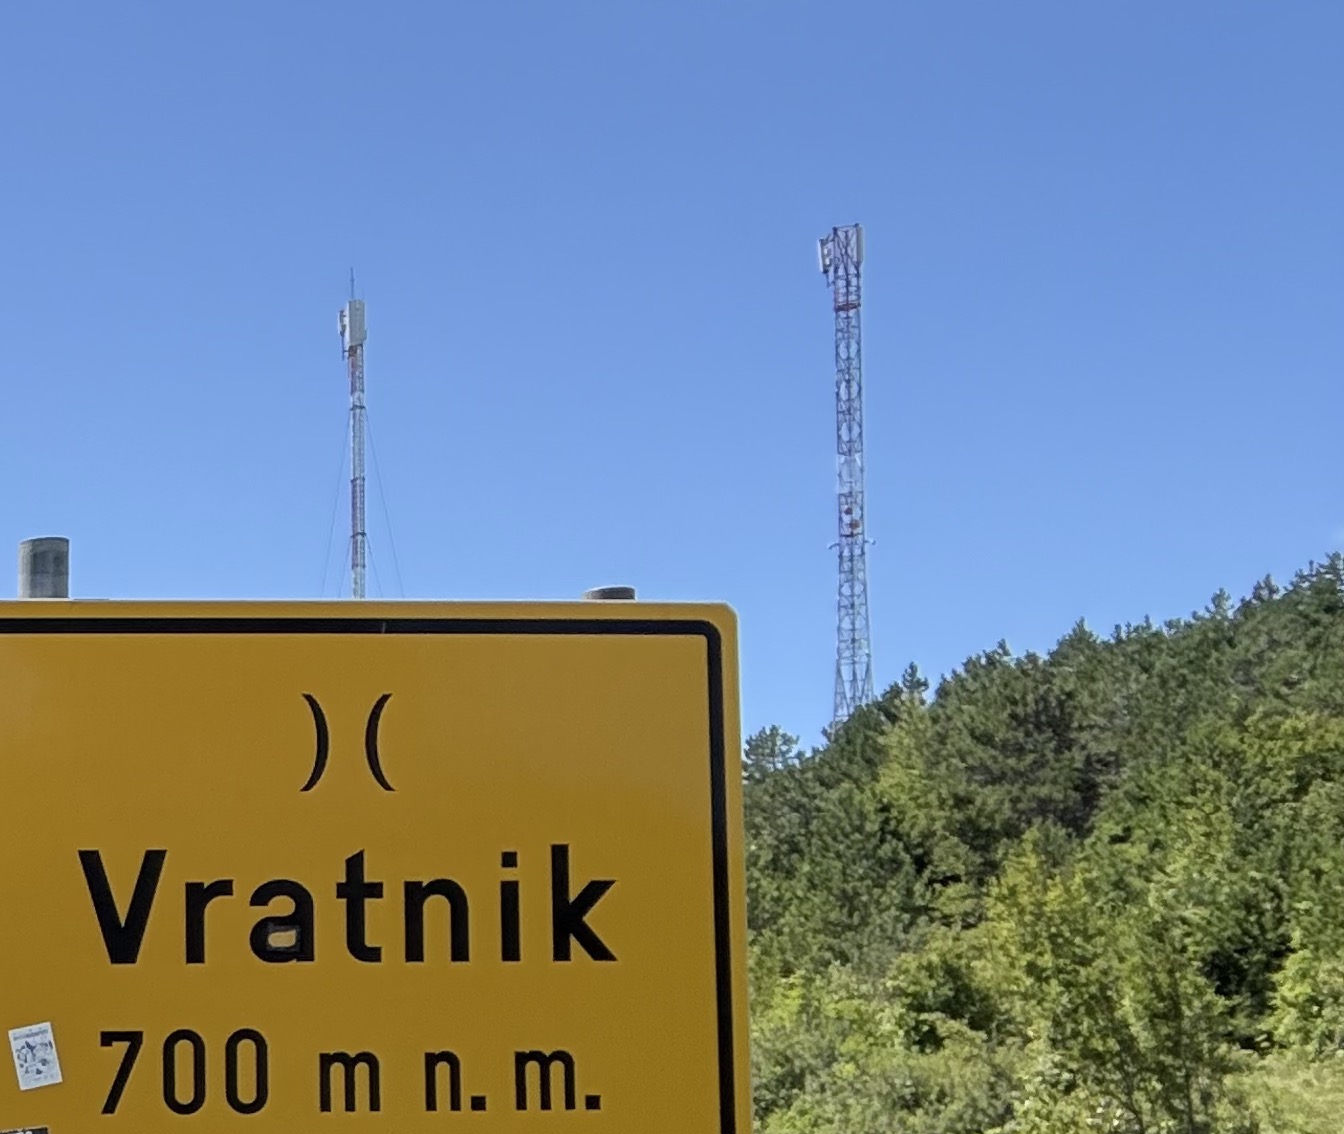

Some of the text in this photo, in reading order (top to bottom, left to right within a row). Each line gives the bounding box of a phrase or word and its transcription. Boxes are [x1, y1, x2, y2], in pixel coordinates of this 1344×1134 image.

[78, 844, 617, 965] Vratnik
[100, 1029, 269, 1115] 700
[319, 1051, 381, 1112] m
